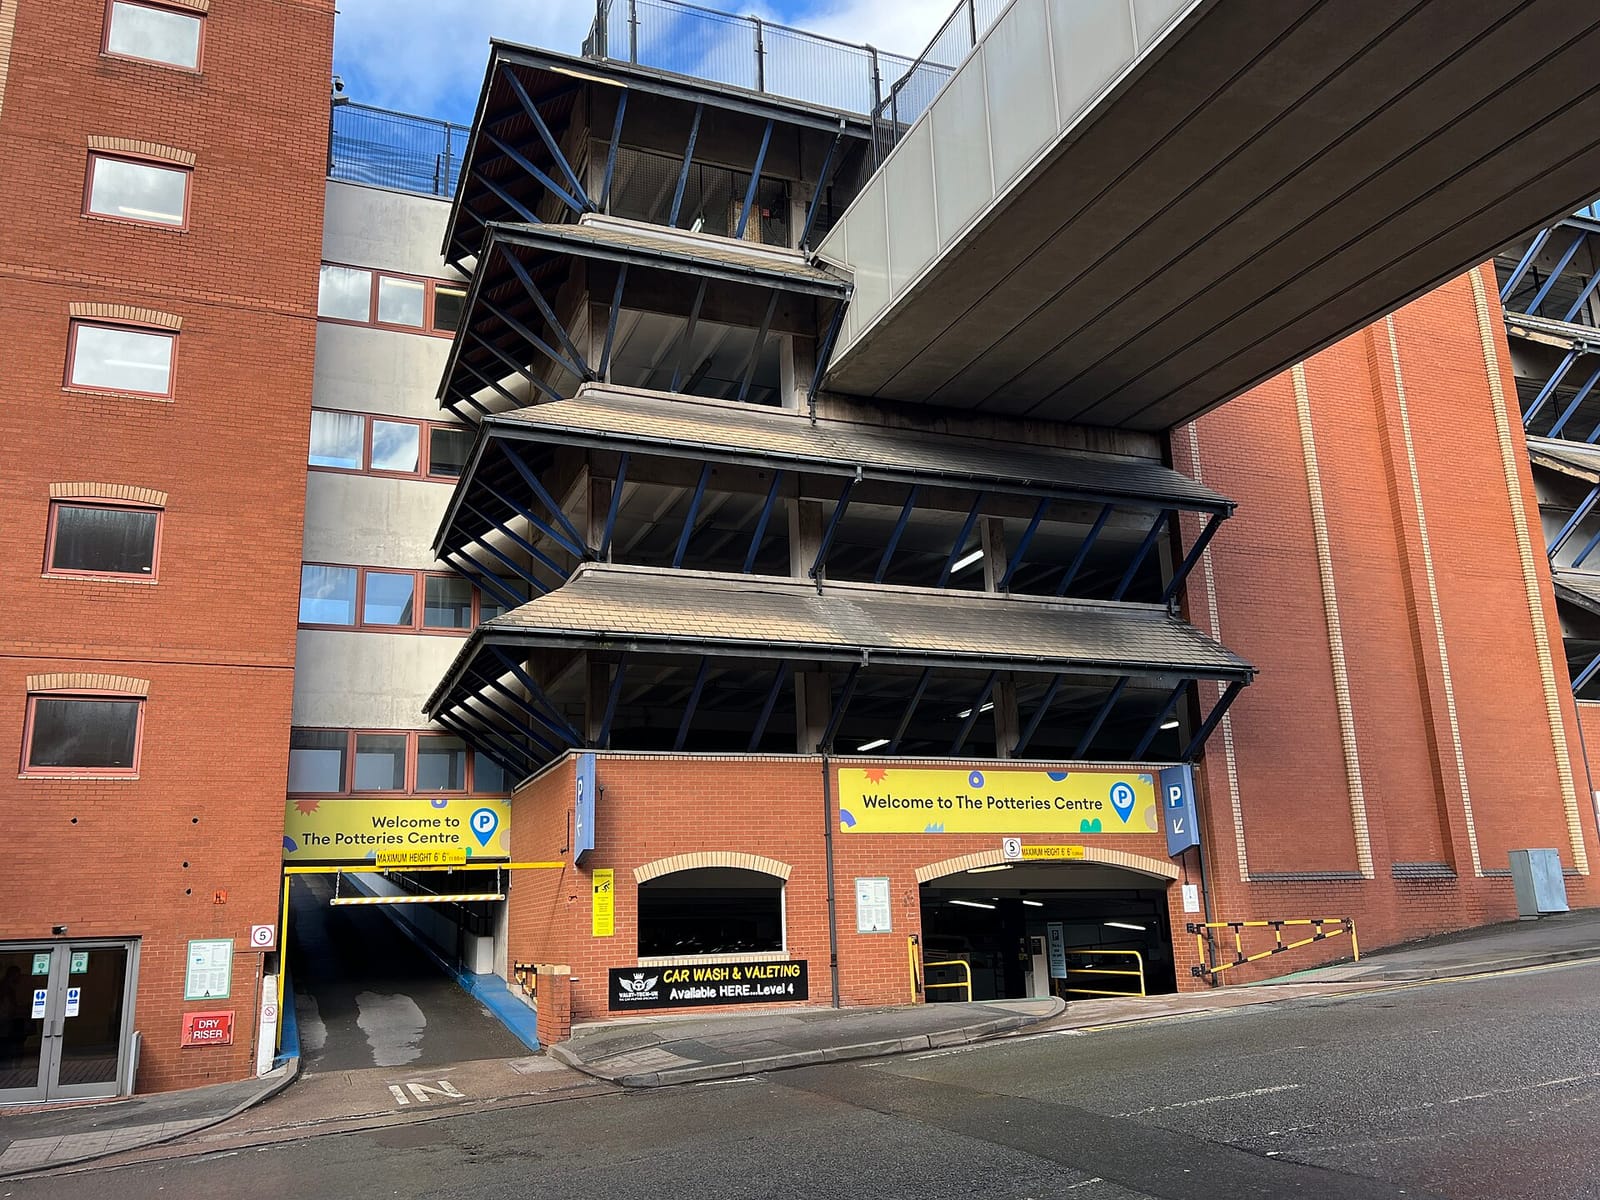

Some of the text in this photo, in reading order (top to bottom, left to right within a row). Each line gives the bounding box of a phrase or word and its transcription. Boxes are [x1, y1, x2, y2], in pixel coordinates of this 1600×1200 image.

[862, 794, 1103, 811] Welcome to The Potteries Centre
[1117, 790, 1128, 803] P
[1169, 786, 1182, 807] P
[372, 816, 460, 829] Welcome to
[479, 815, 490, 829] P
[302, 832, 460, 846] The Potteries Centre
[1009, 841, 1016, 852] 5
[1022, 848, 1043, 856] MAXIMUM
[1044, 848, 1060, 857] HEIGHT
[377, 853, 408, 863] MAXIMUM
[409, 852, 432, 863] HEIGHT
[259, 930, 267, 941] 5
[663, 964, 801, 984] CAR WASH & VALETING
[669, 985, 717, 1000] Available
[787, 983, 794, 995] 4
[198, 1018, 220, 1029] DRY
[193, 1029, 223, 1040] RISER
[388, 1081, 466, 1105] IN
